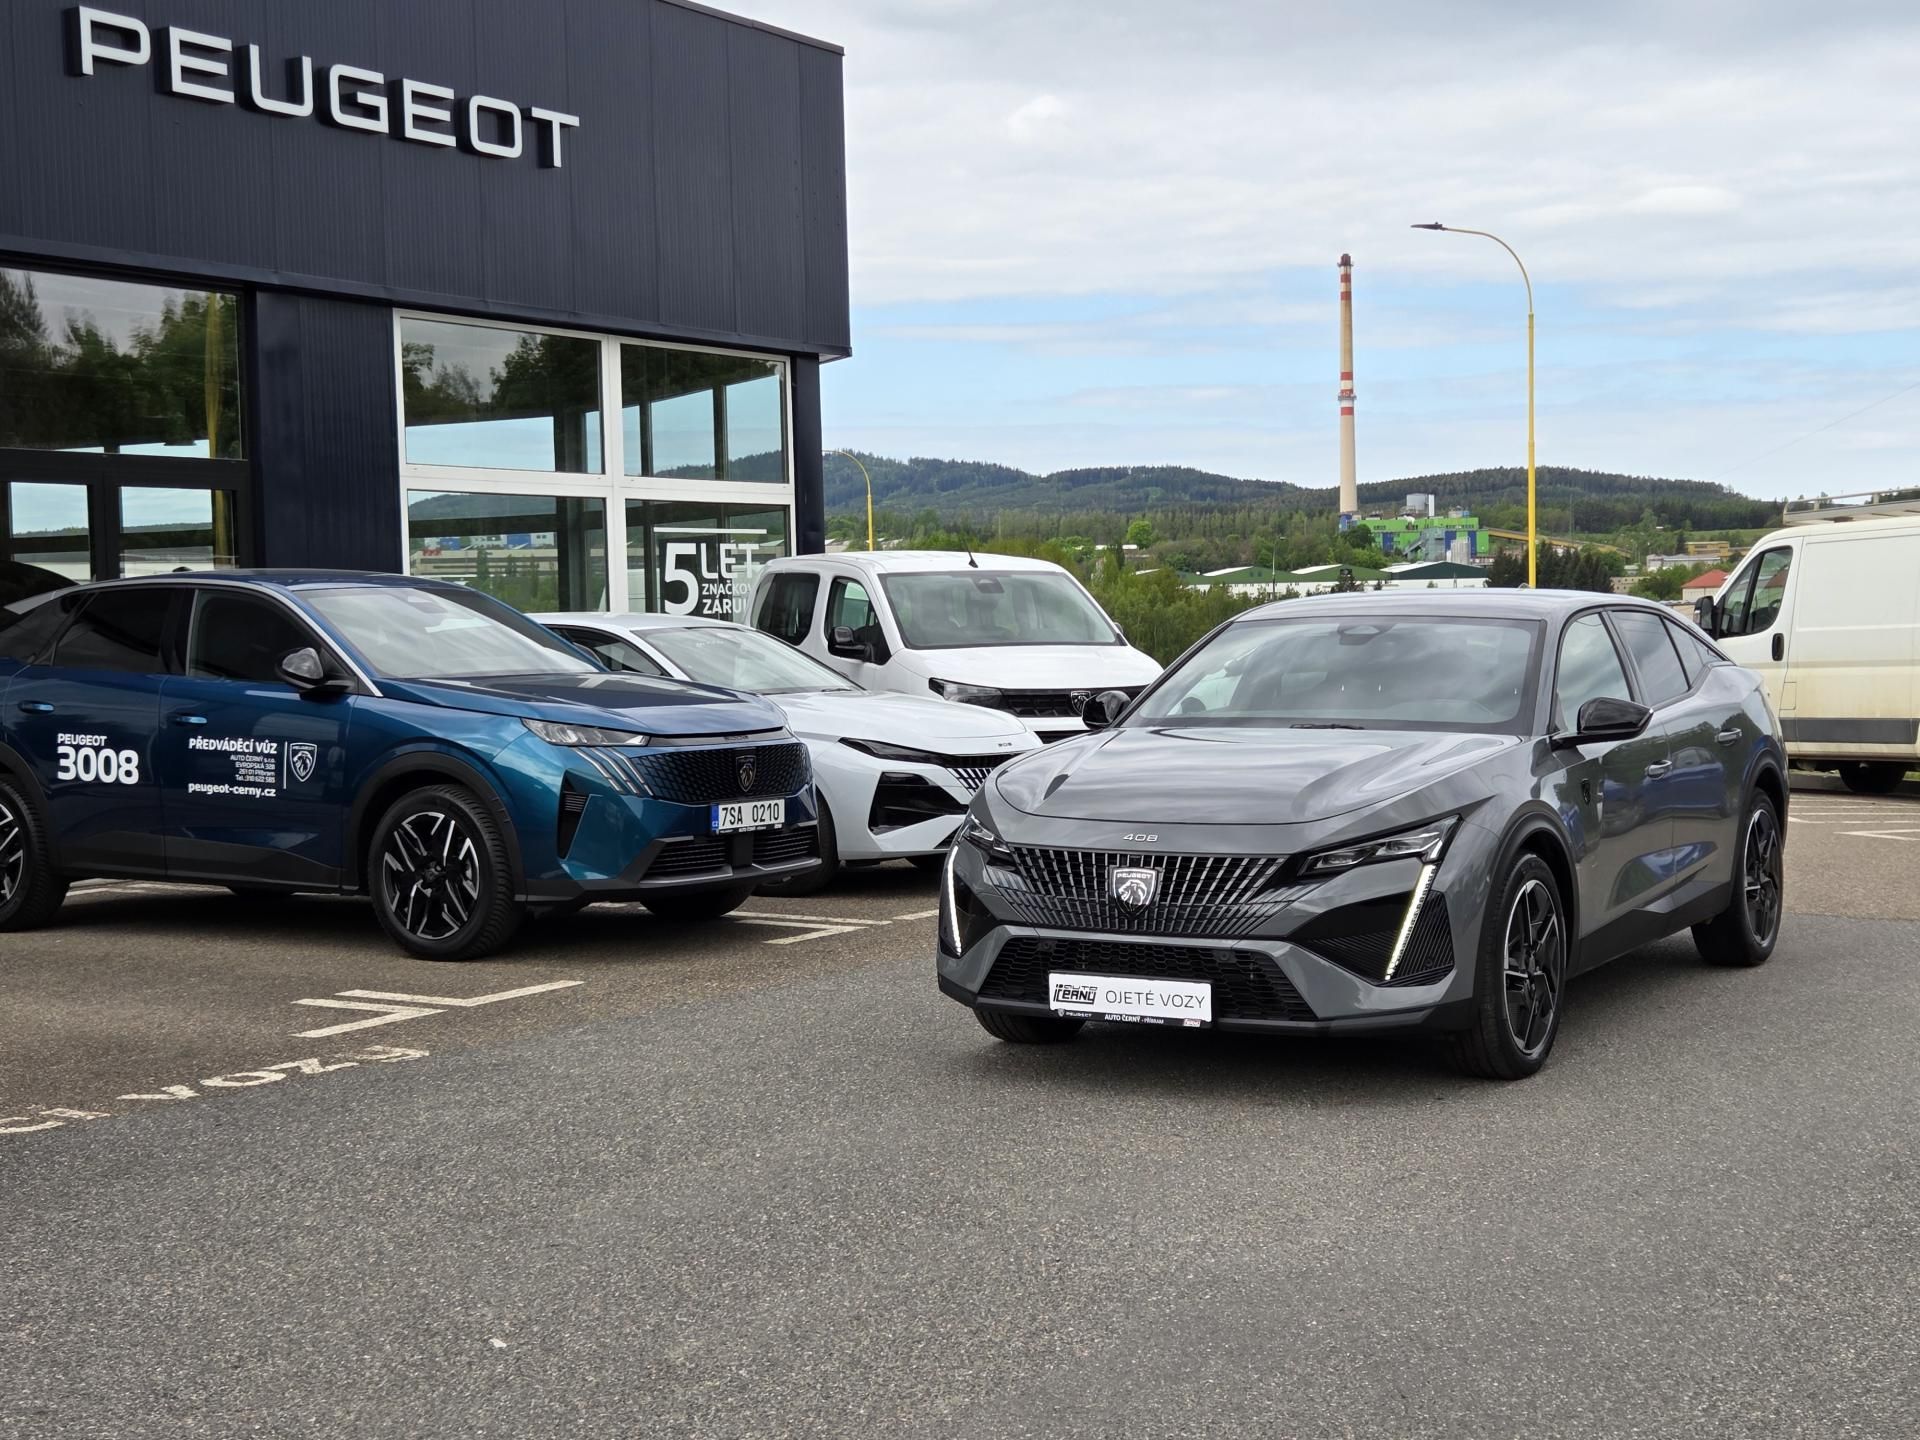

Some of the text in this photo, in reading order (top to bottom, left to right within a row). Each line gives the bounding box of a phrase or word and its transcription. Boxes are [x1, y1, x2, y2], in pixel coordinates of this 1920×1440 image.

[77, 4, 580, 168] PEUGEOT
[664, 542, 760, 615] 5 LET
[57, 733, 107, 746] PEUGEOT
[188, 736, 278, 754] PŘEDVÁDĚCÍ VŮZ
[57, 745, 139, 785] 3008
[188, 783, 277, 798] peugeot-cerny.cz
[722, 803, 780, 827] 7SA 0210
[1123, 833, 1159, 842] 408
[1105, 990, 1206, 1009] OJETÉ VOZY
[1122, 1014, 1141, 1023] ČERNÝ
